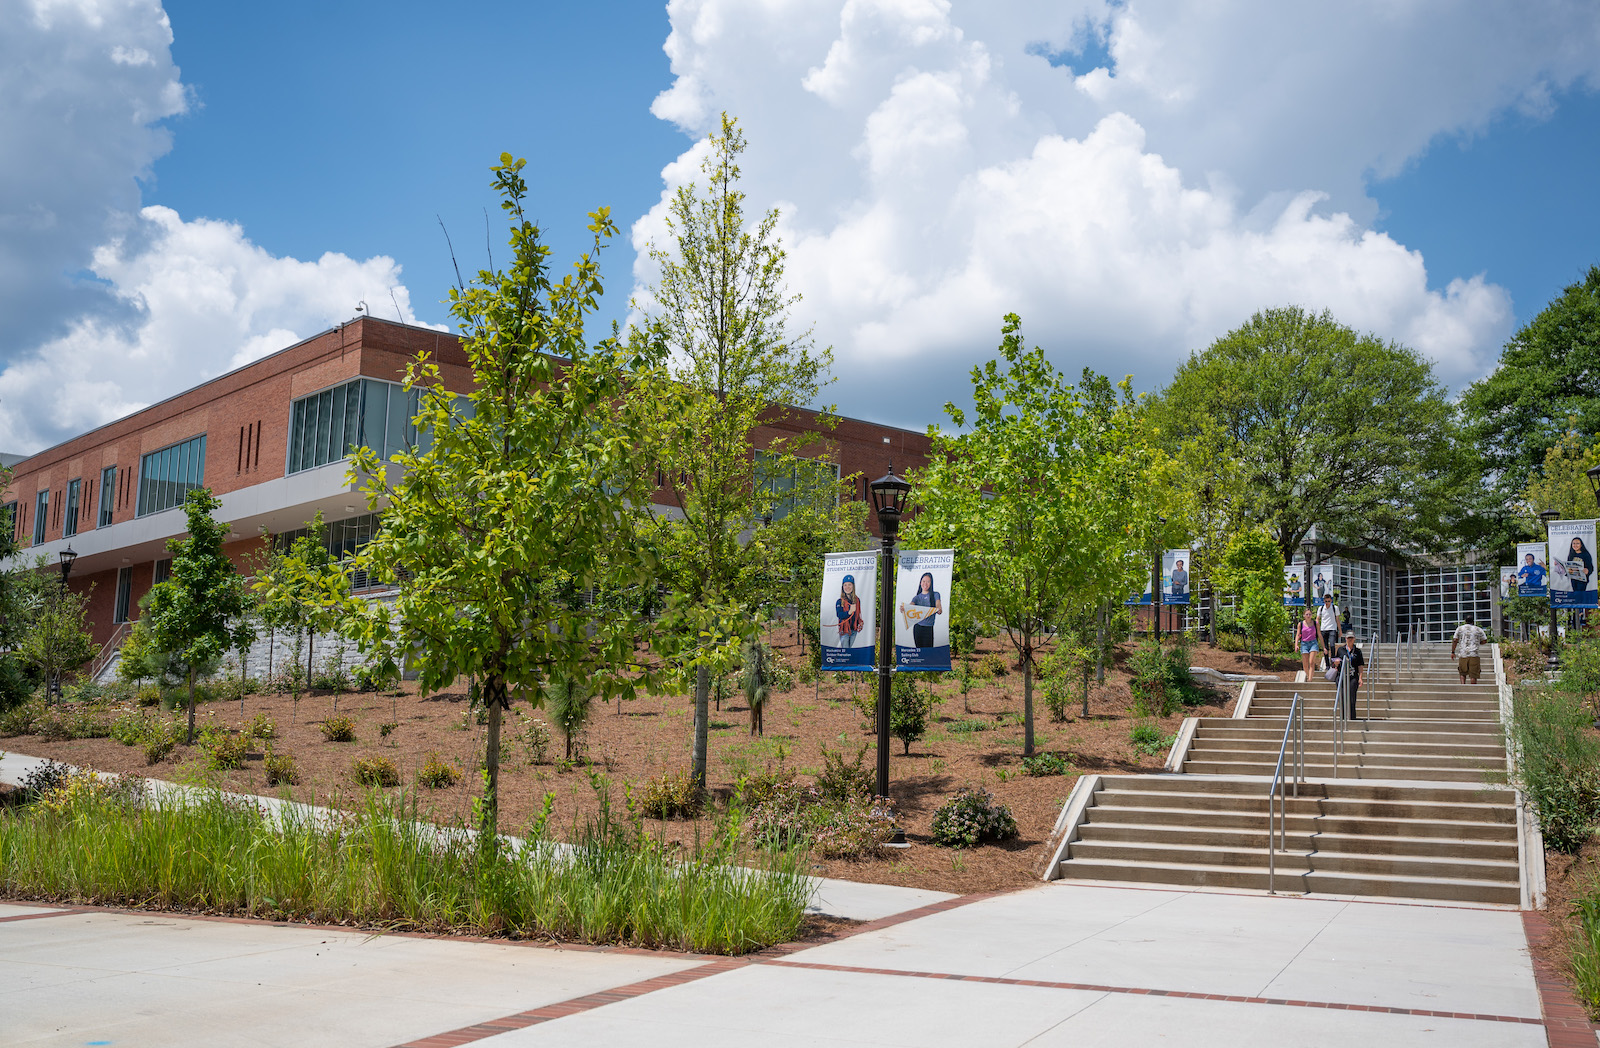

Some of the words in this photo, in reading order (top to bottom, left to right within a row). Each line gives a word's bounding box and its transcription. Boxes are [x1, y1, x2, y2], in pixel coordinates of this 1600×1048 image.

[826, 557, 875, 567] CELEBRATING
[901, 555, 951, 565] CELEBRATING
[907, 608, 923, 620] GT
